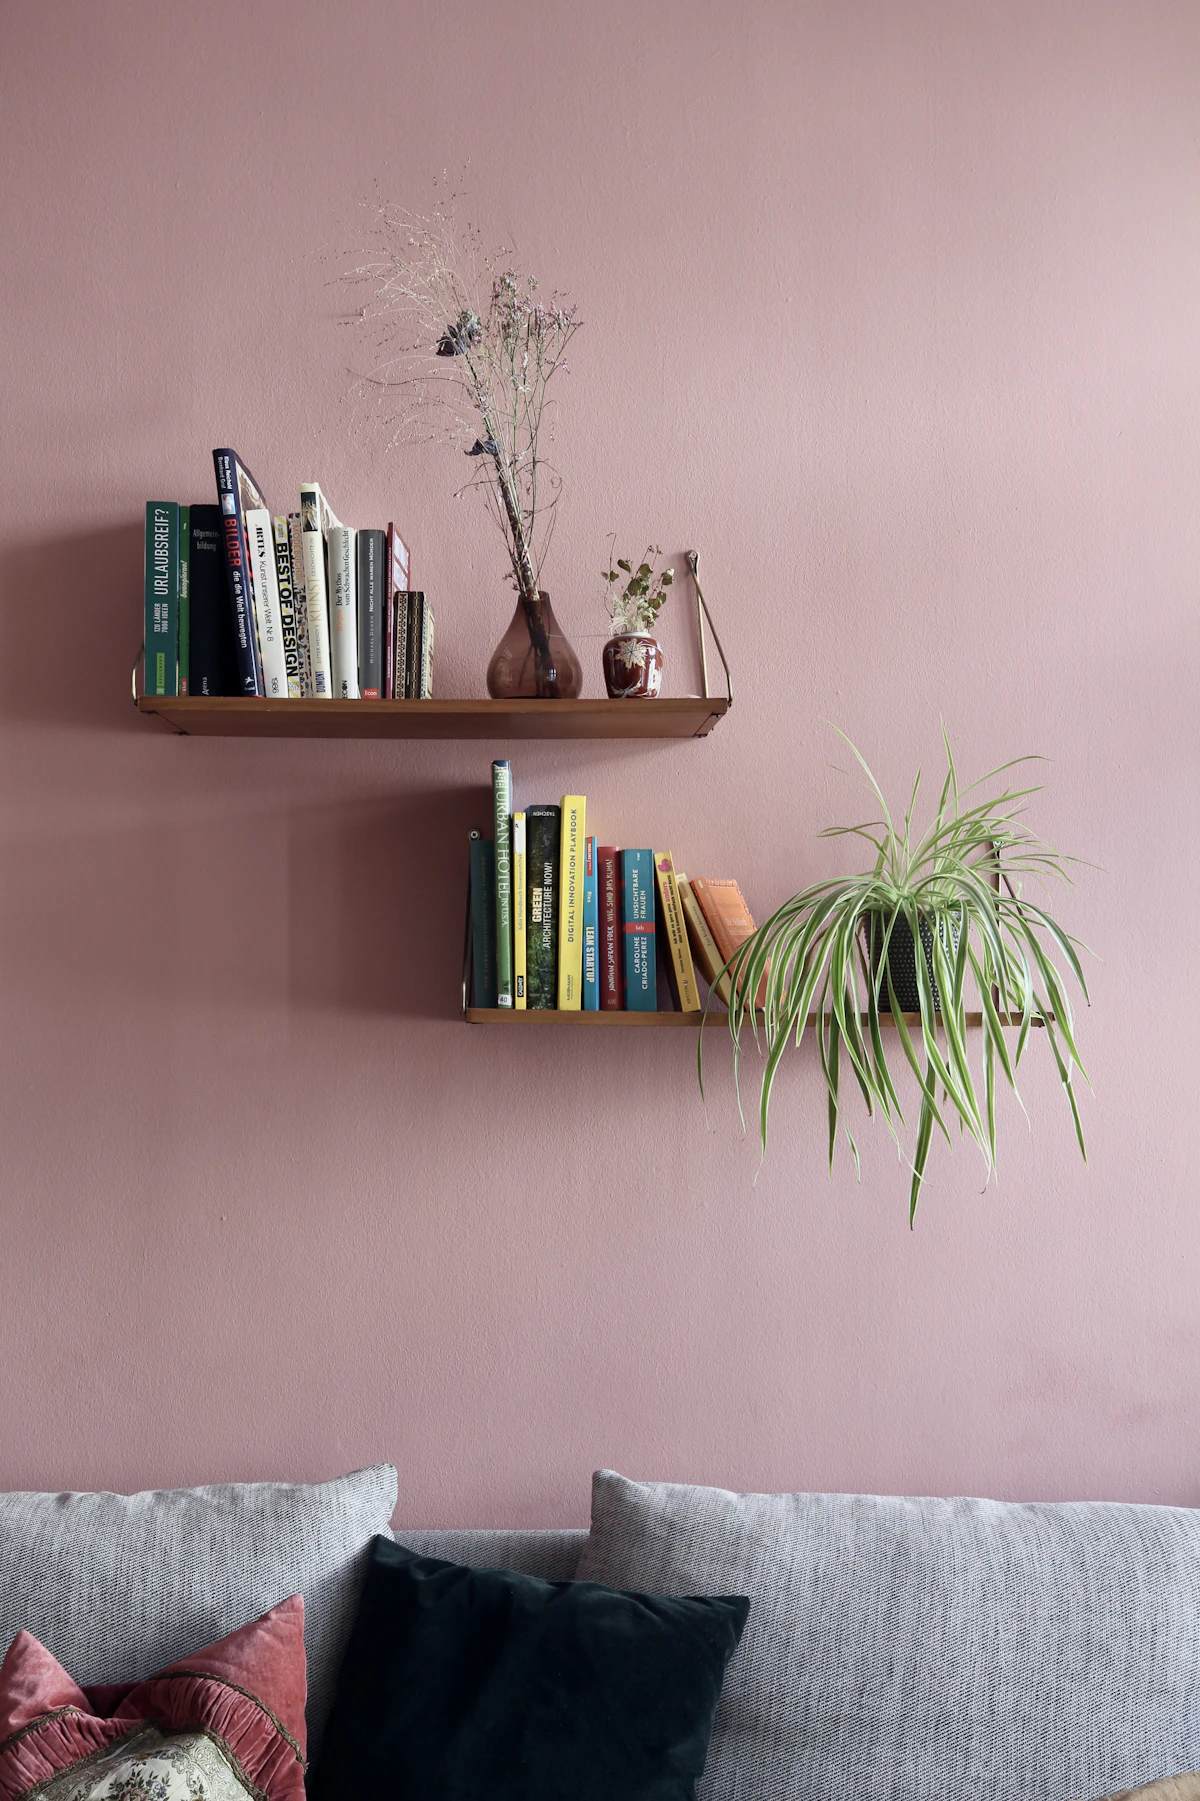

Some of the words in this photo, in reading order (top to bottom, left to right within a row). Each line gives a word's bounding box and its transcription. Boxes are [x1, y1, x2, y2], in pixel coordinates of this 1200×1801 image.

[193, 529, 220, 541] Allgemein-
[197, 542, 217, 552] bildung
[224, 518, 242, 567] BILDER
[154, 508, 169, 595] URLAUBSREIF?
[233, 571, 241, 582] die
[259, 560, 268, 581] Kunst
[276, 543, 292, 586] BEST
[180, 560, 189, 598] buongiorno!
[234, 584, 242, 594] die
[336, 572, 344, 594] Mythos
[343, 561, 351, 593] Schwachen
[236, 596, 245, 612] Welt
[261, 581, 270, 608] unserer
[280, 588, 293, 610] OF
[306, 577, 323, 622] KUNST
[335, 595, 343, 606] Der
[153, 603, 161, 622] LÄNDER
[264, 609, 272, 624] Welt
[238, 614, 247, 649] bewegten
[282, 615, 299, 677] DESIGN
[202, 677, 210, 695] Arena
[496, 791, 510, 844] URBAN
[569, 809, 577, 852] PLAYBOOK
[498, 848, 511, 898] HOTEL
[543, 862, 553, 884] NOW!
[605, 859, 613, 879] KLIMA!
[568, 855, 576, 908] INNOVATION
[662, 882, 671, 902] anders
[532, 887, 543, 922] GREEN
[542, 886, 552, 948] ARCHITECTURE
[586, 926, 594, 946] LEAN
[586, 947, 595, 983] STARTUP
[607, 942, 615, 964] SAFRAN
[607, 965, 616, 991] JONATHAN
